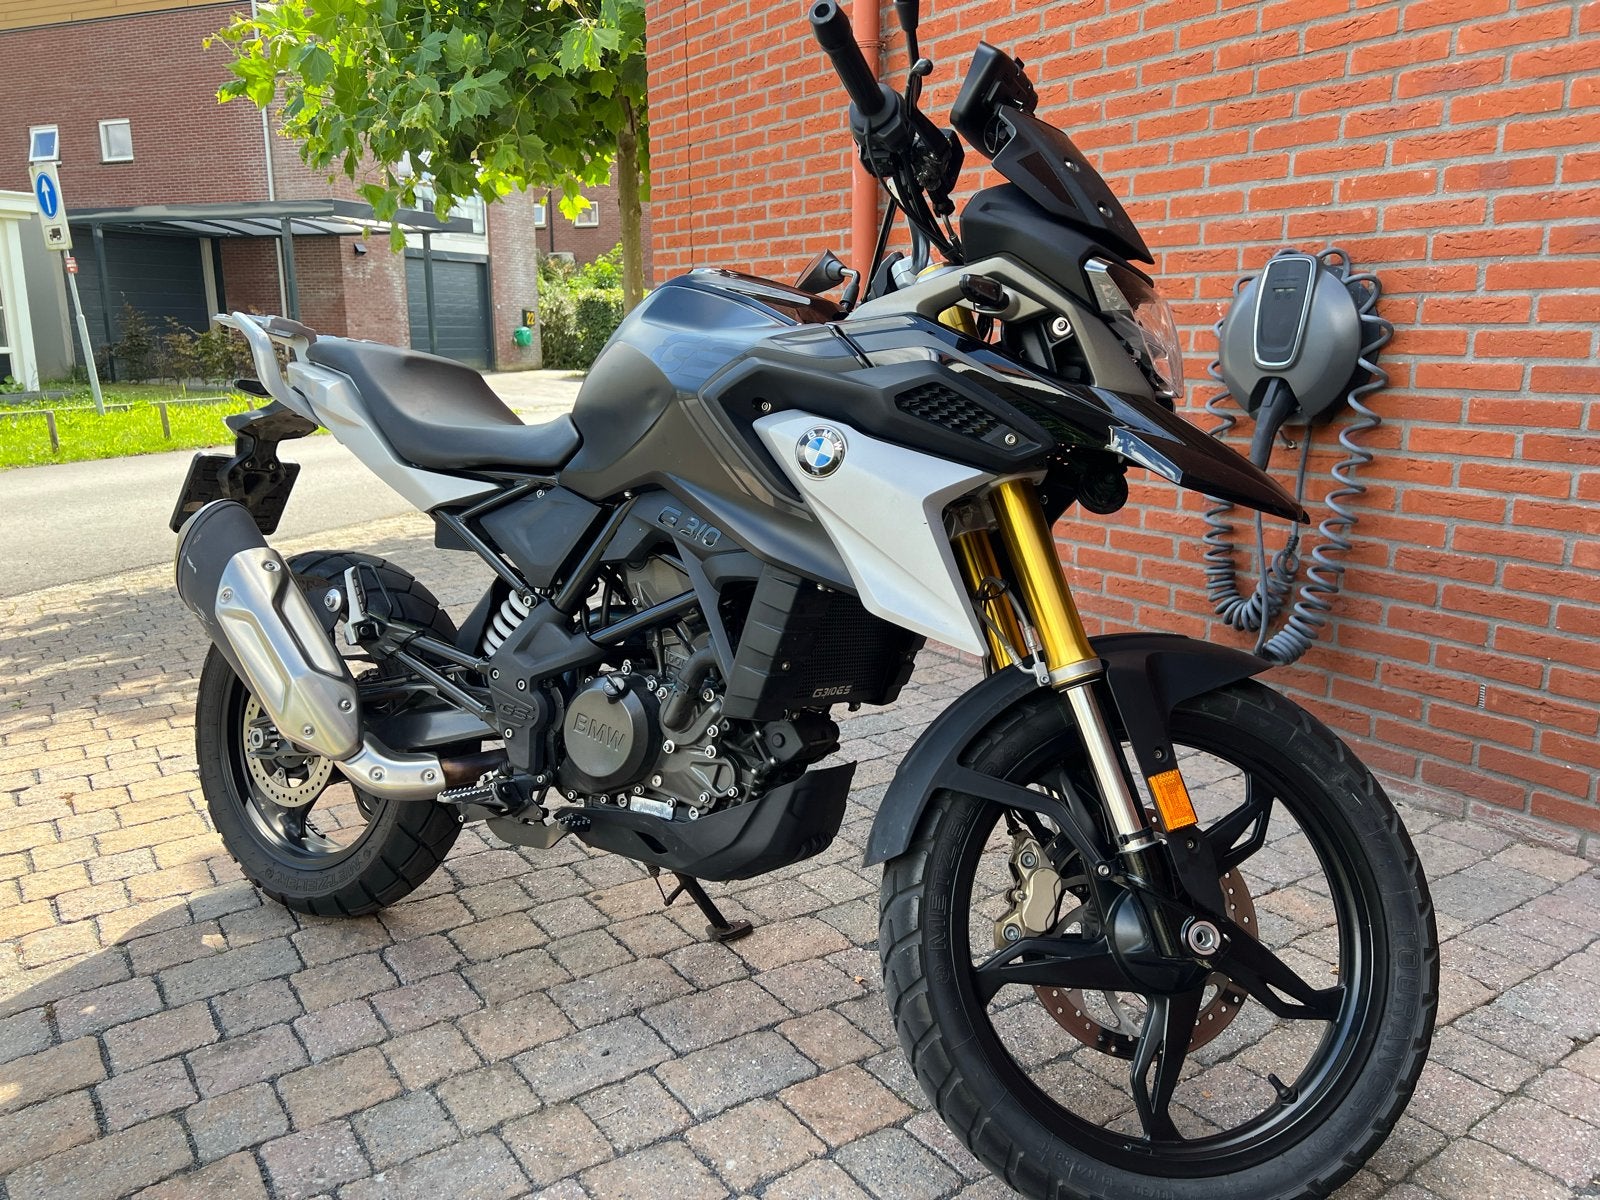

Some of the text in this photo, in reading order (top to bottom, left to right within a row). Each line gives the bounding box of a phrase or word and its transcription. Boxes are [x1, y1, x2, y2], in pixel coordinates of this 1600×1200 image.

[807, 429, 843, 451] BMW
[657, 506, 722, 547] G 310
[573, 712, 625, 752] BMW
